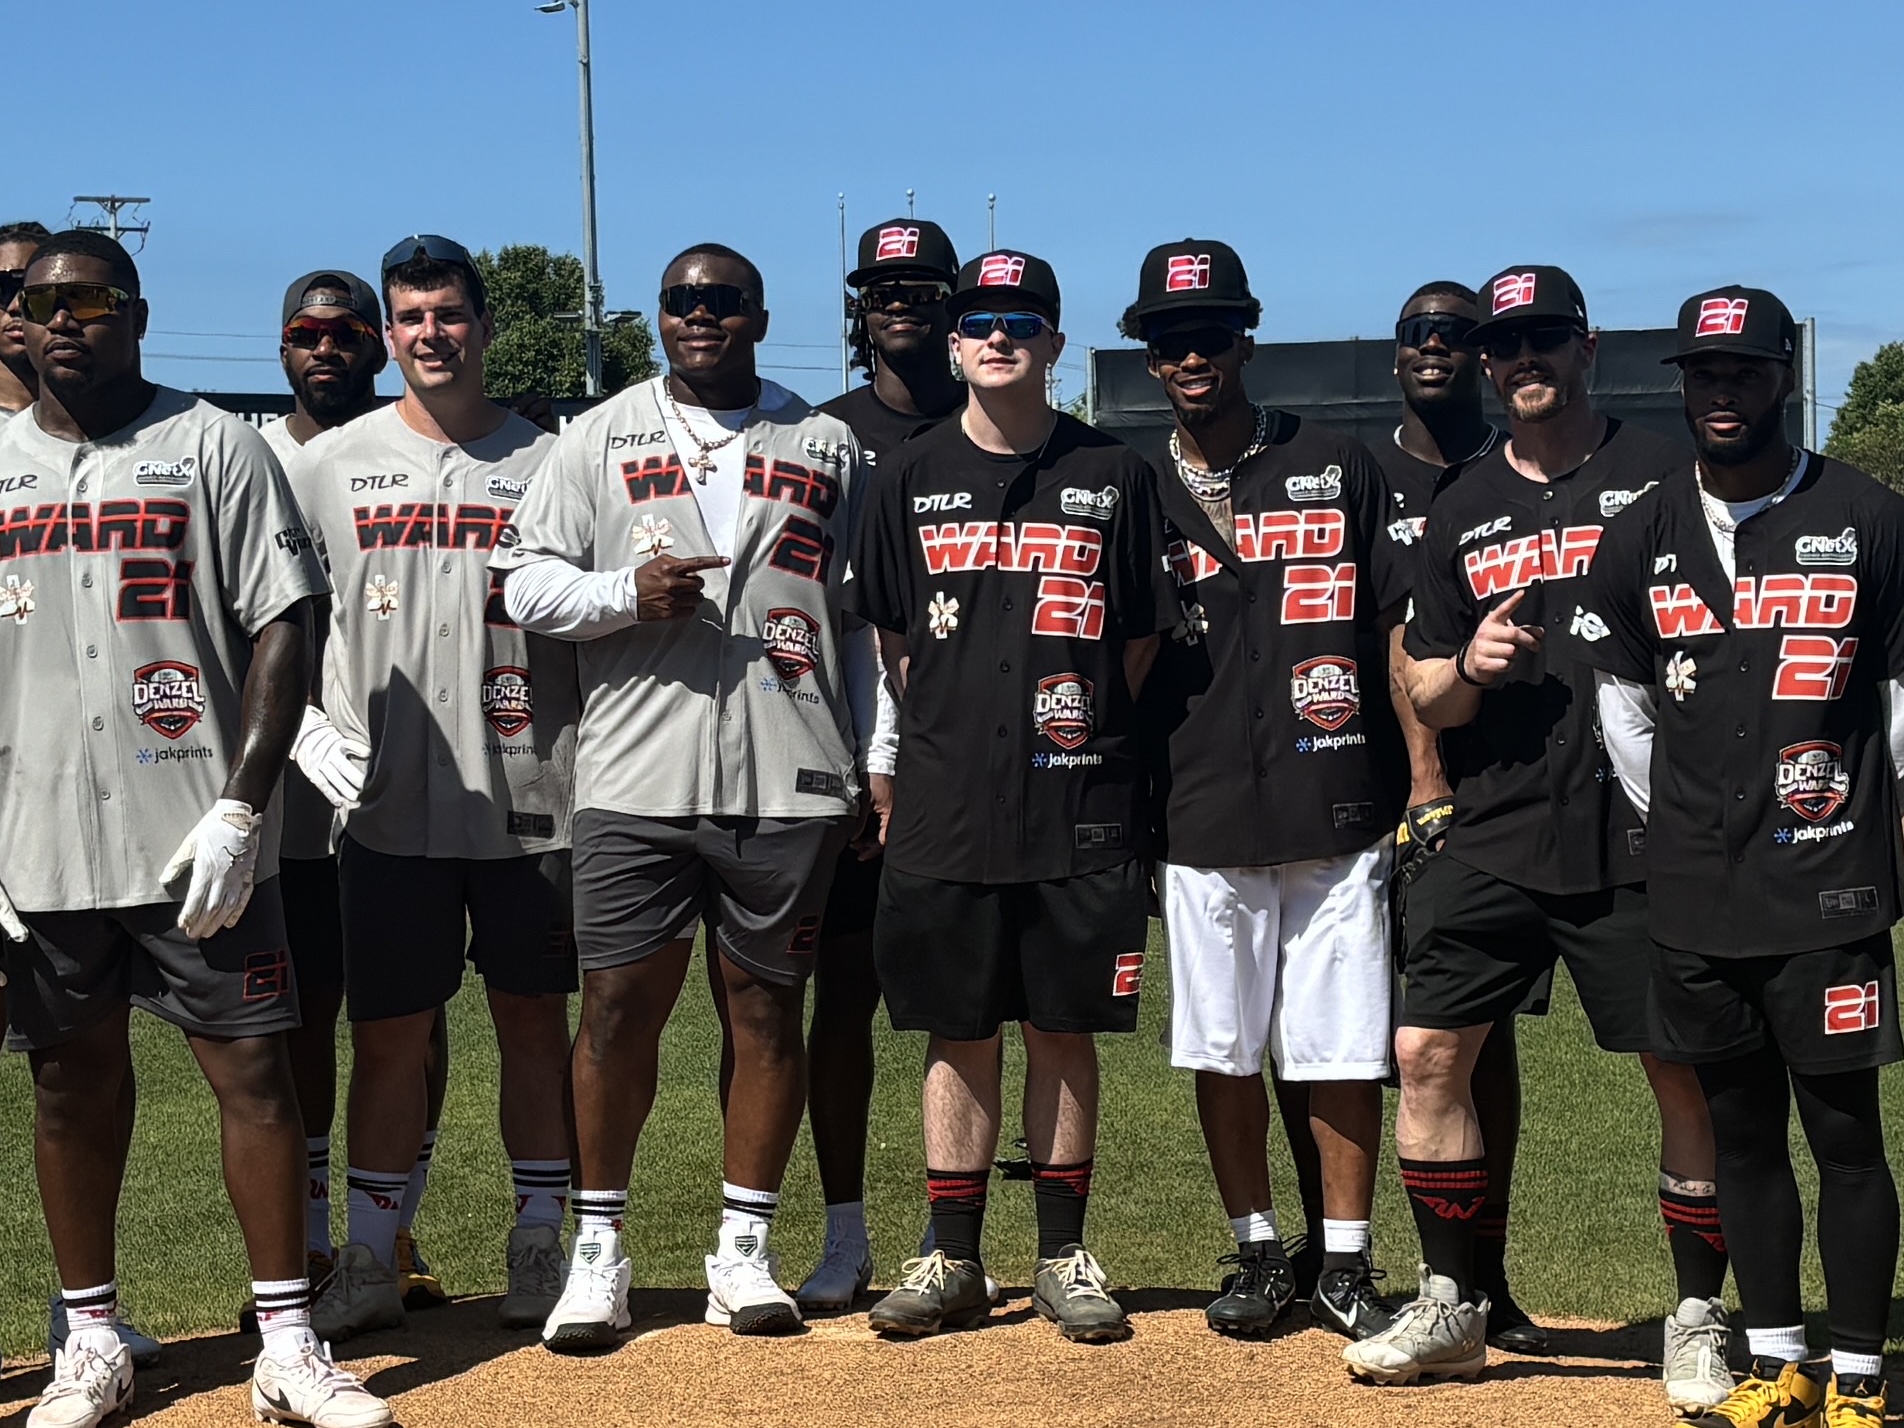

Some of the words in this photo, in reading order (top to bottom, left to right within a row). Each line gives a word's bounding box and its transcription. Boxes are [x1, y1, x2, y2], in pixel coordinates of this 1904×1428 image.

[1695, 297, 1749, 338] 21
[609, 429, 666, 450] DTLR
[349, 473, 410, 492] DTLR
[912, 490, 973, 515] DTLR
[918, 521, 1103, 577] WARD
[1463, 525, 1605, 601] WAR
[116, 557, 196, 622] 21
[1031, 575, 1106, 640] 21
[1280, 562, 1357, 626] 21
[1648, 573, 1859, 639] WARD
[1292, 675, 1361, 699] DENZEL
[1771, 635, 1859, 702] 21
[133, 676, 206, 706] DENZEL
[153, 744, 214, 763] jakprints
[1047, 751, 1103, 770] jakprints
[1776, 761, 1848, 788] DENZEL
[1792, 820, 1855, 844] jakprints
[1112, 952, 1144, 997] 2
[1824, 980, 1880, 1035] 21
